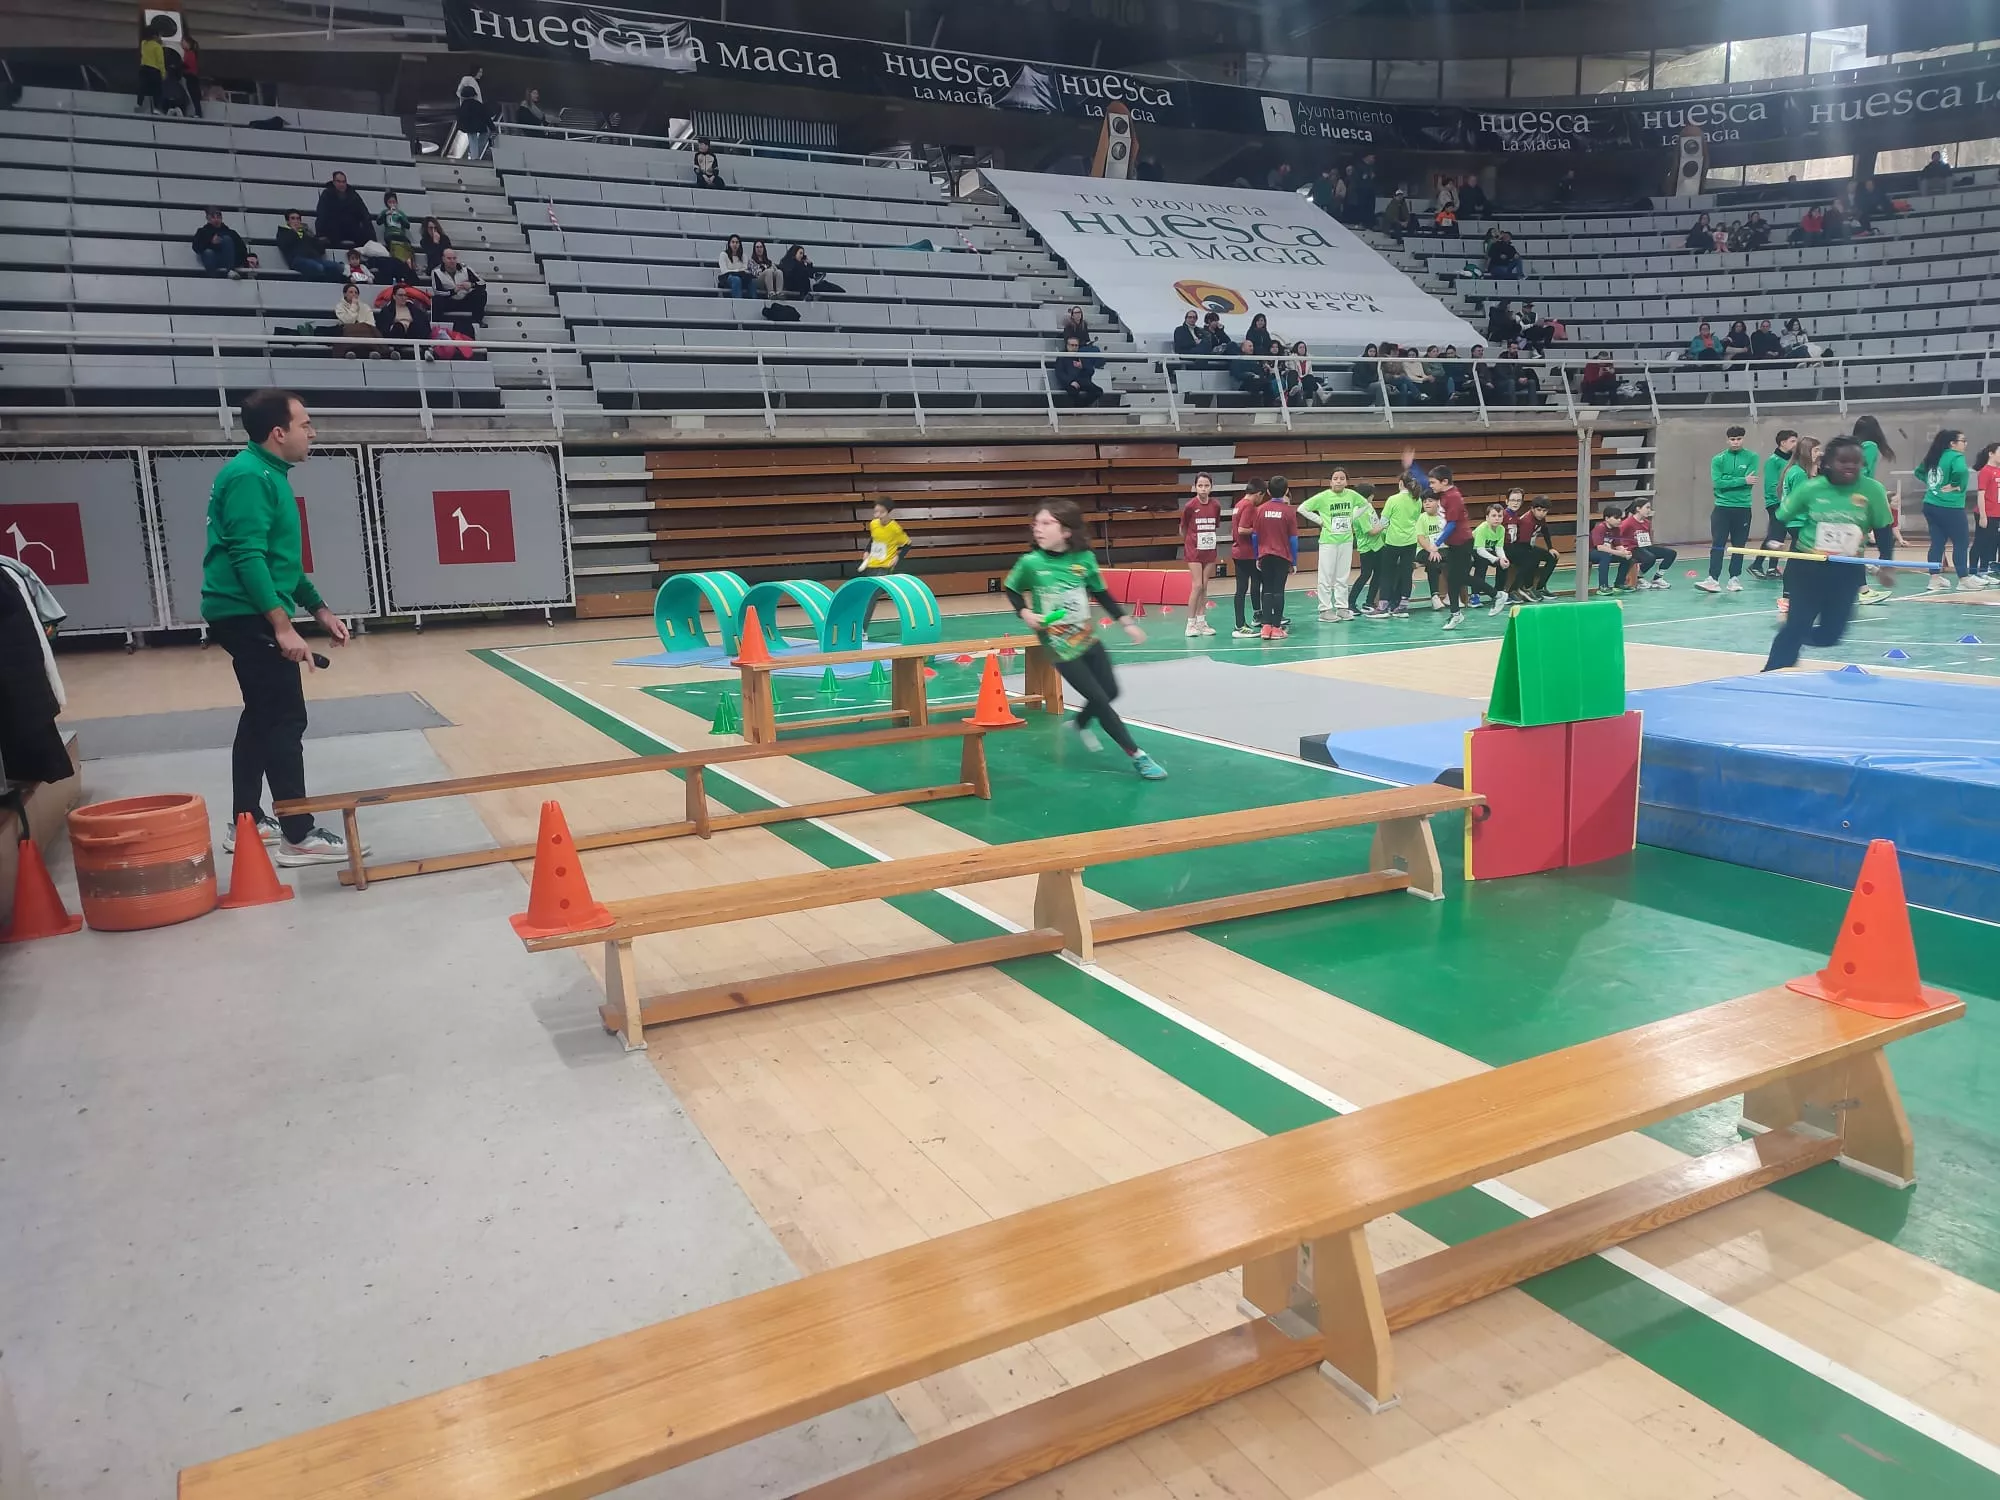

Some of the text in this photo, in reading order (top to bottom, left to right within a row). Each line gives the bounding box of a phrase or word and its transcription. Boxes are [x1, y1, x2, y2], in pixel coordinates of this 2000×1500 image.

[470, 8, 649, 57] Huesca
[660, 30, 709, 64] La
[882, 52, 1012, 88] Huesca
[913, 86, 935, 100] La
[1059, 74, 1174, 106] Huesca
[1085, 104, 1104, 118] La
[1297, 101, 1393, 125] Ayuntamiento
[1641, 102, 1768, 129] Huesca
[1809, 85, 1963, 124] Huesca
[1300, 123, 1373, 143] de Huesca
[1479, 111, 1591, 134] Huesca
[1502, 138, 1519, 151] La
[1662, 135, 1680, 146] La
[1054, 209, 1339, 248] Huesca
[1121, 238, 1184, 260] La
[1260, 299, 1384, 313] HUESCA
[1264, 511, 1282, 519] LUCAS
